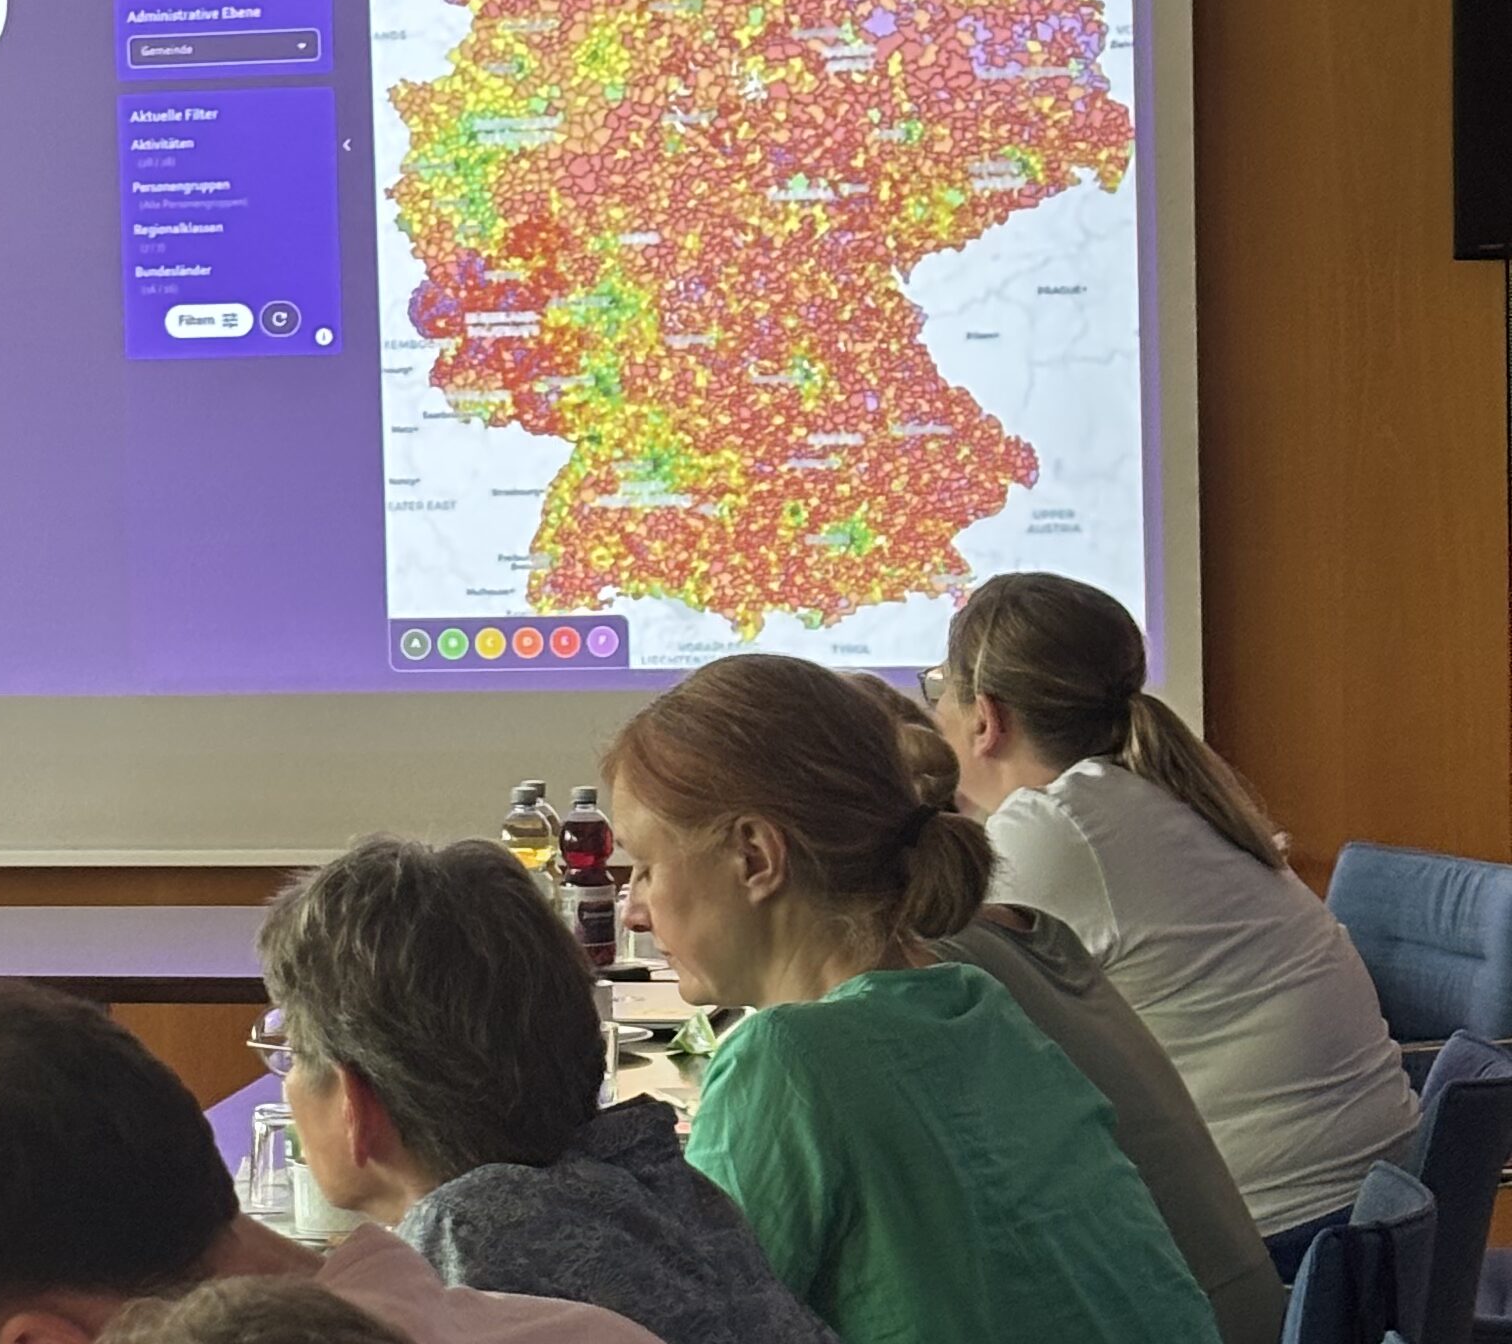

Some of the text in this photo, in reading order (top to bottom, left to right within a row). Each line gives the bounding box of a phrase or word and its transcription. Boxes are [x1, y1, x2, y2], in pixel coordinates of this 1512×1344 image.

[127, 6, 262, 24] Administrative Ebene
[129, 107, 219, 123] Aktuelle Filter
[130, 137, 195, 152] Aktivitäten
